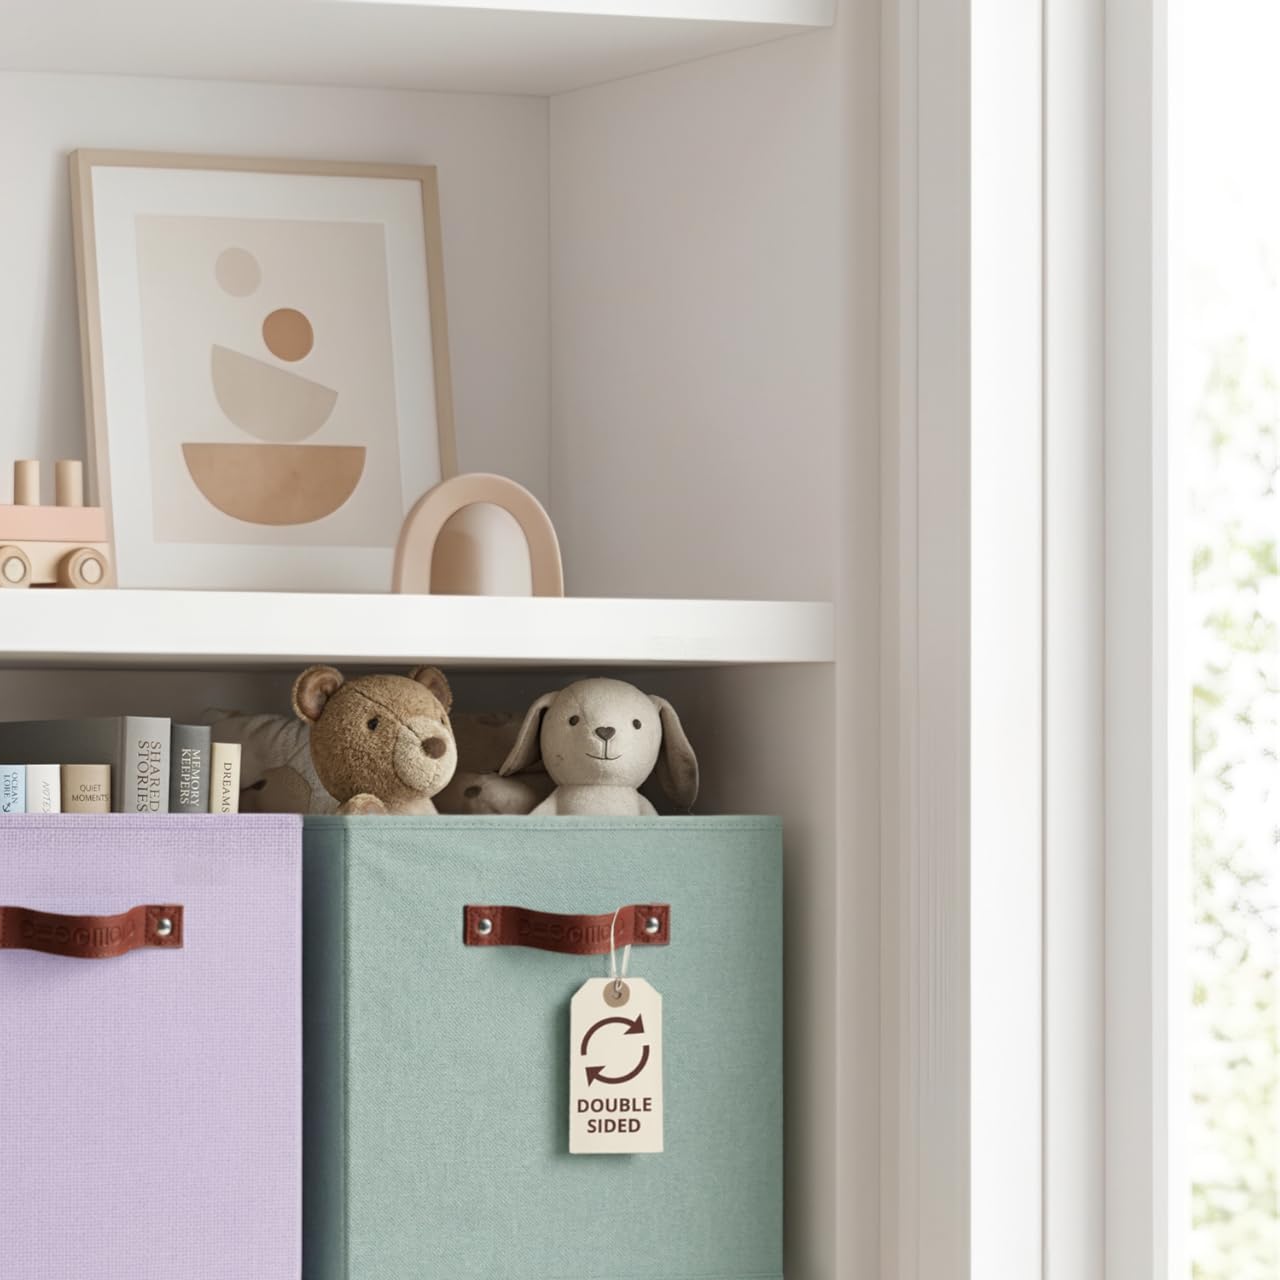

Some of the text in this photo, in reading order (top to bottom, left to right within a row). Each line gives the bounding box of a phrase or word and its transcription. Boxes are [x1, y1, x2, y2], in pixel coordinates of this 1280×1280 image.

[3, 774, 11, 798] LORE
[11, 771, 19, 804] OCEAN
[80, 784, 102, 793] QUIET
[136, 740, 149, 813] STORIES
[149, 741, 161, 812] SHARED
[180, 748, 191, 805] KEEPERS
[190, 748, 201, 807] MEMORY
[221, 762, 232, 813] DREAMS
[71, 794, 109, 802] MOMENTS
[577, 1097, 652, 1113] DOUBLE
[587, 1118, 641, 1133] SIDED
